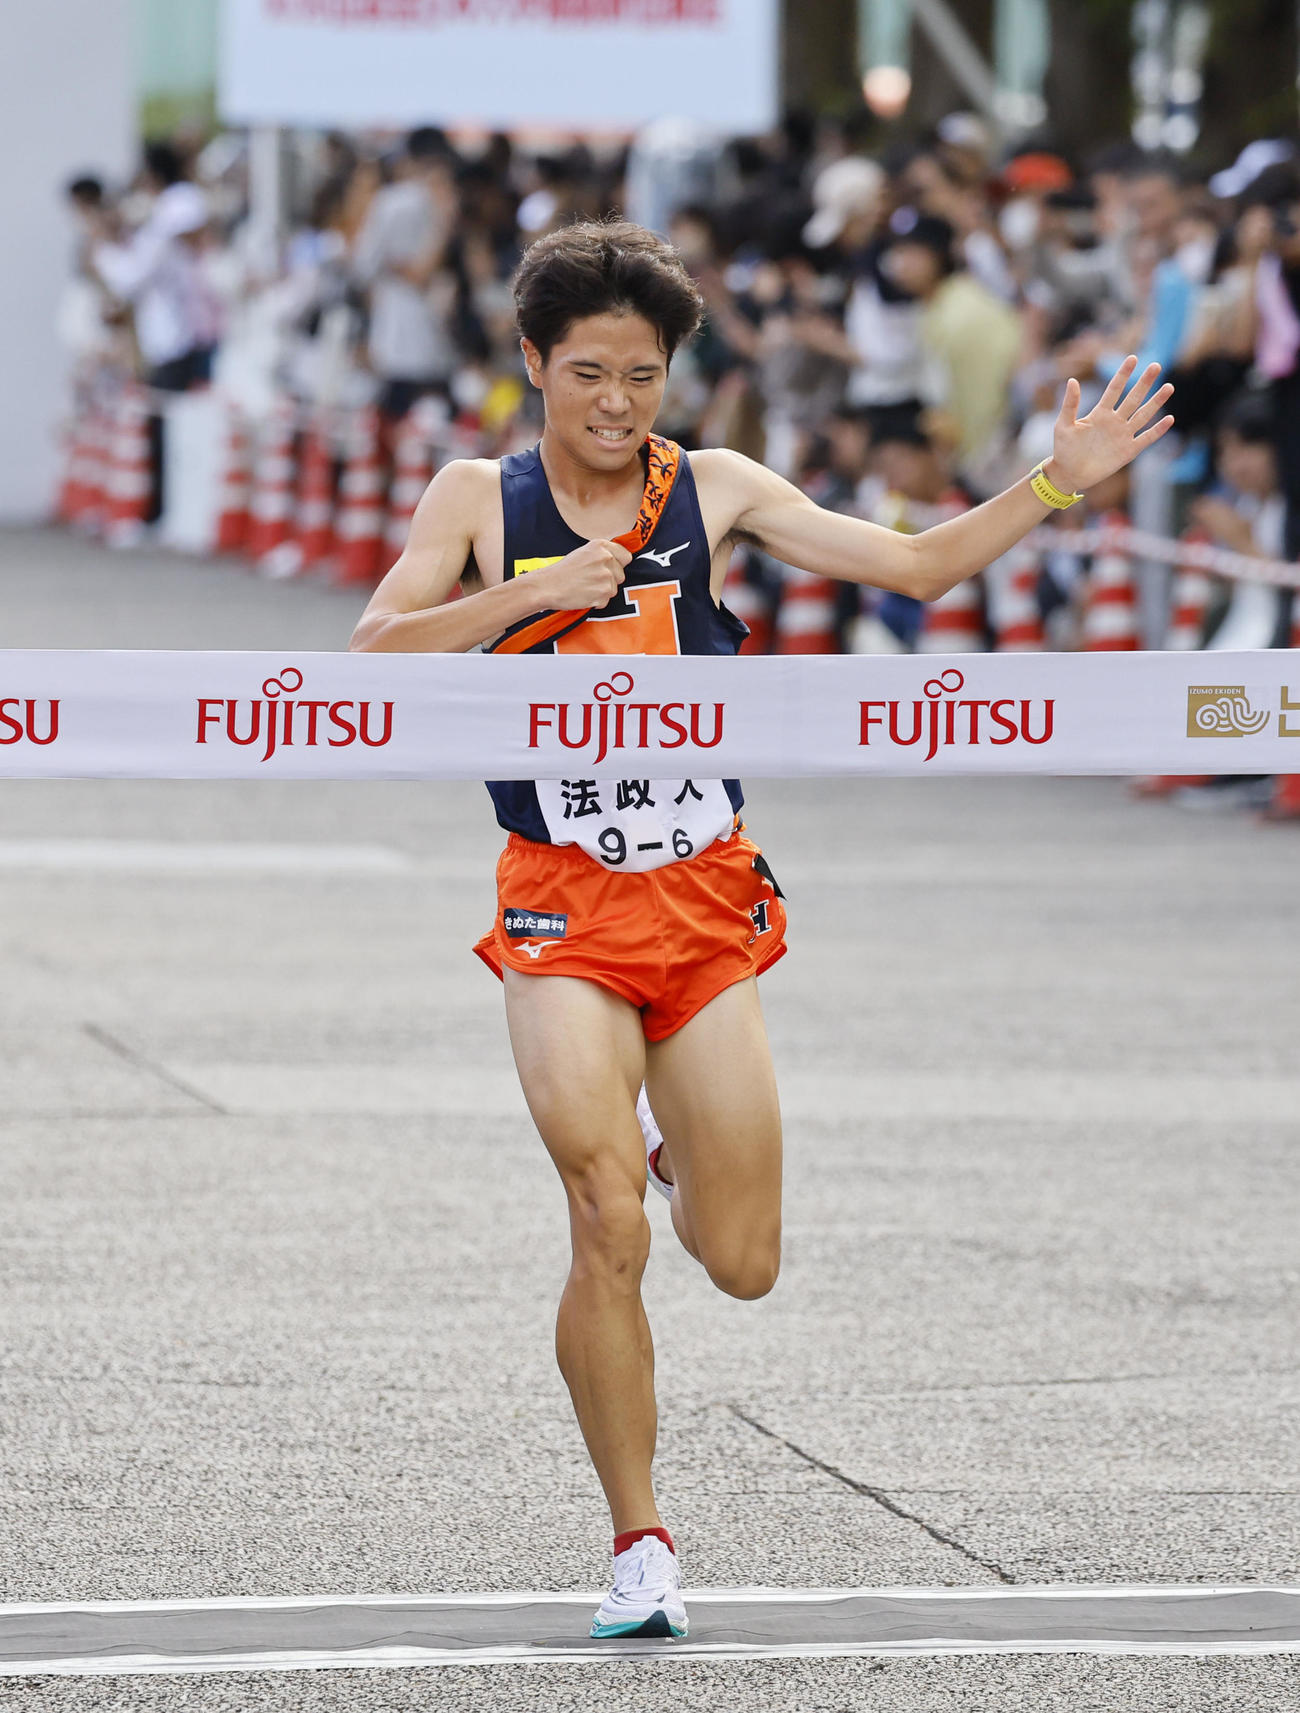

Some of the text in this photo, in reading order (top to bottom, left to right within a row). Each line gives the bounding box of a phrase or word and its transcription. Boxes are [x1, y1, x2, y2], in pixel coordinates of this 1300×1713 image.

[196, 667, 395, 762] FUJITSU
[528, 671, 725, 765] FUJITSU
[859, 669, 1055, 762] FUJITSU
[505, 916, 565, 932] きぬた歯科
